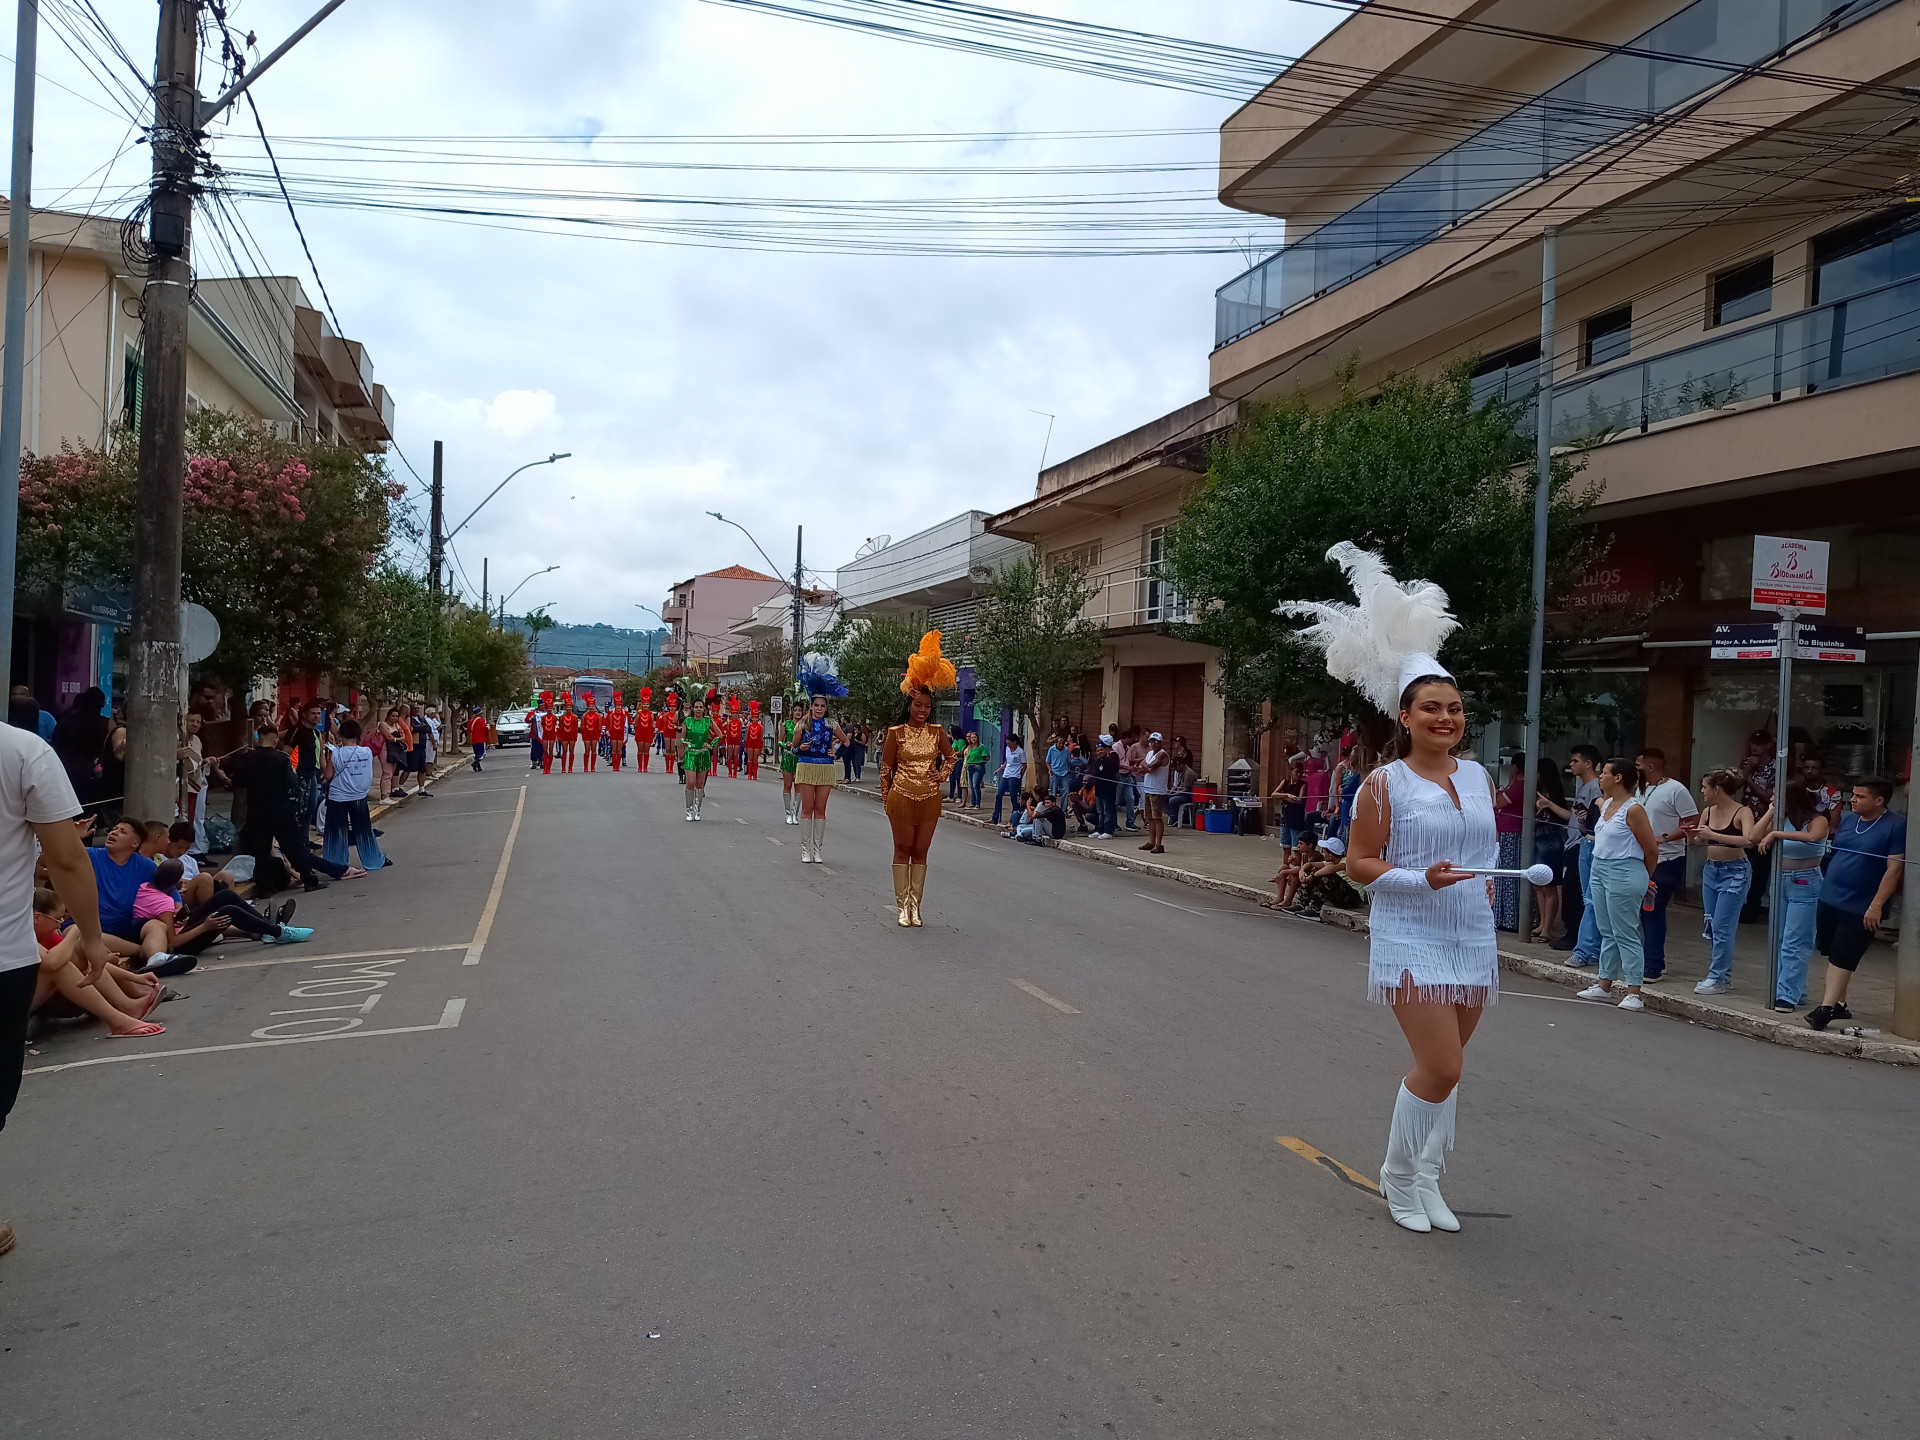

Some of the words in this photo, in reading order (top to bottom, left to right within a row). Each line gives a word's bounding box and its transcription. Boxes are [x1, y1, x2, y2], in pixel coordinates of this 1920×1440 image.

[1799, 624, 1817, 632] RUA
[1811, 639, 1845, 648] Biquinha
[250, 958, 406, 1039] MOTO
